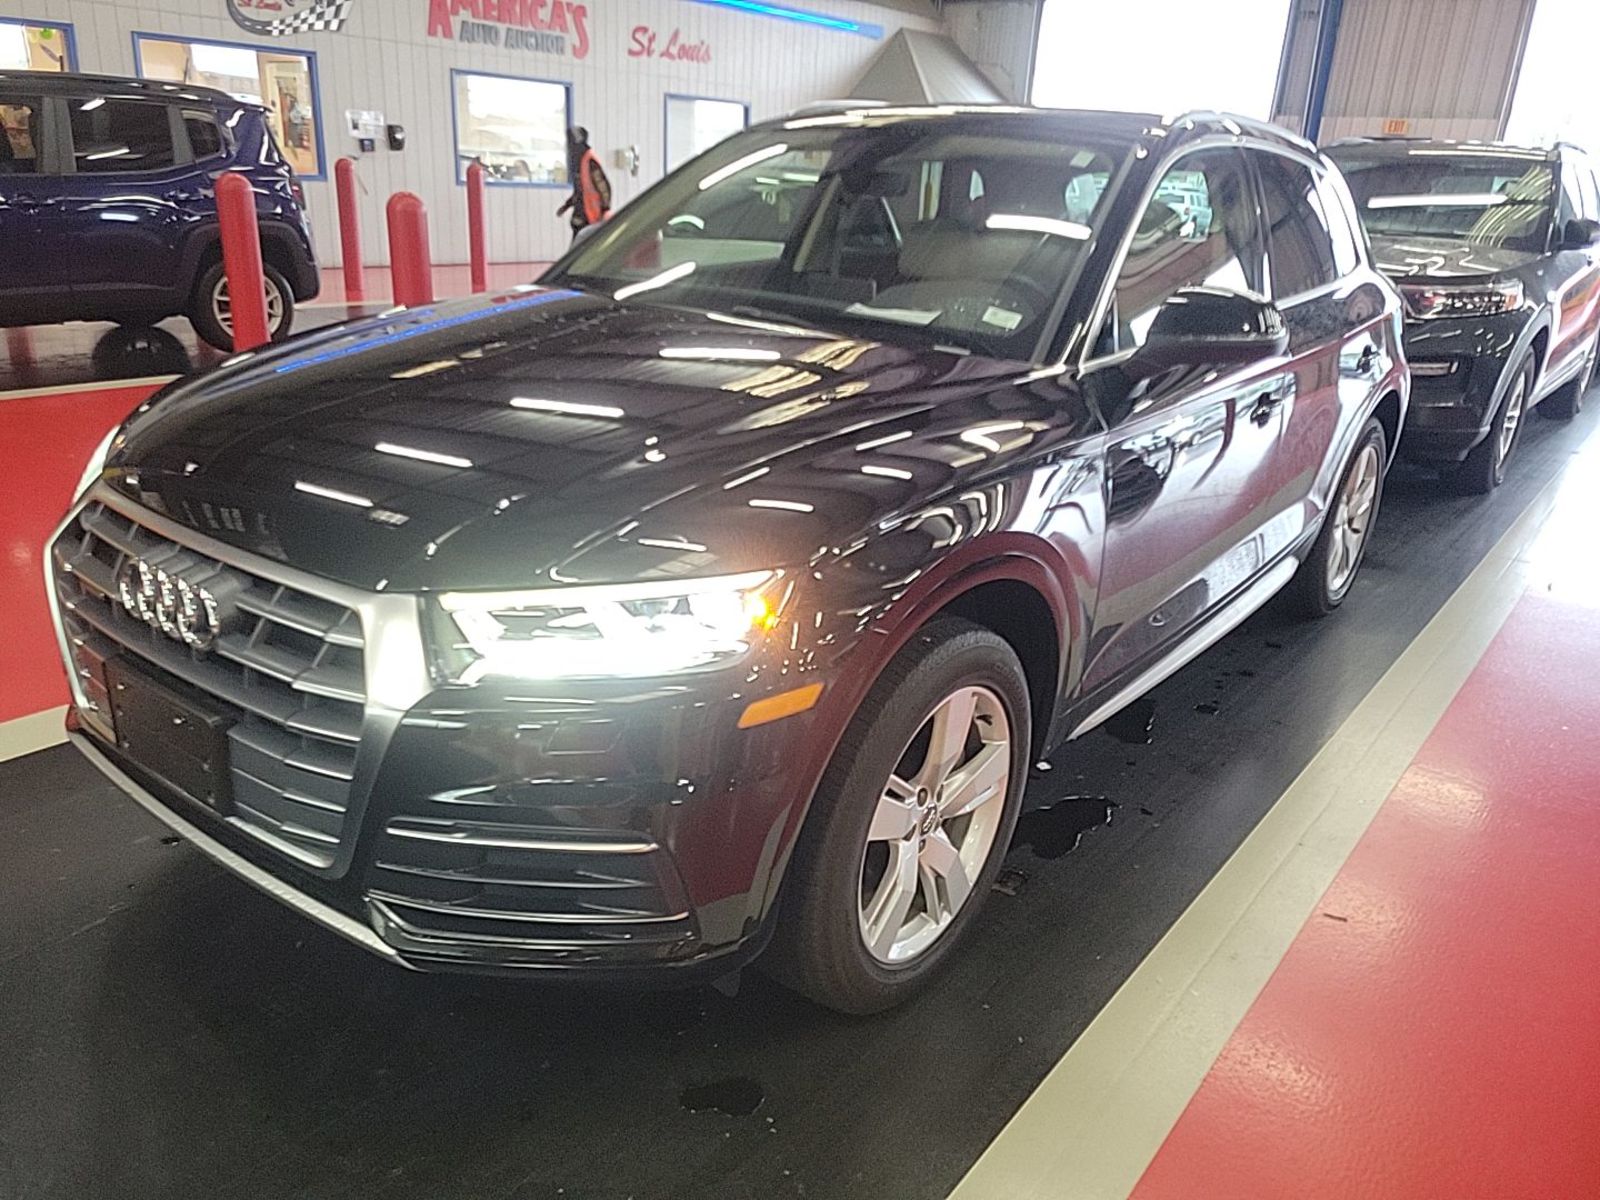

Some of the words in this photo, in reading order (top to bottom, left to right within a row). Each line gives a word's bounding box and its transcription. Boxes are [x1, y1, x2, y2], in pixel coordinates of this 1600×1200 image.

[427, 0, 590, 60] AMERICA'S
[459, 20, 499, 46] AUTO
[504, 27, 566, 55] AUCTION
[627, 26, 656, 57] St
[659, 27, 712, 64] Louis
[1388, 120, 1406, 133] EXIT
